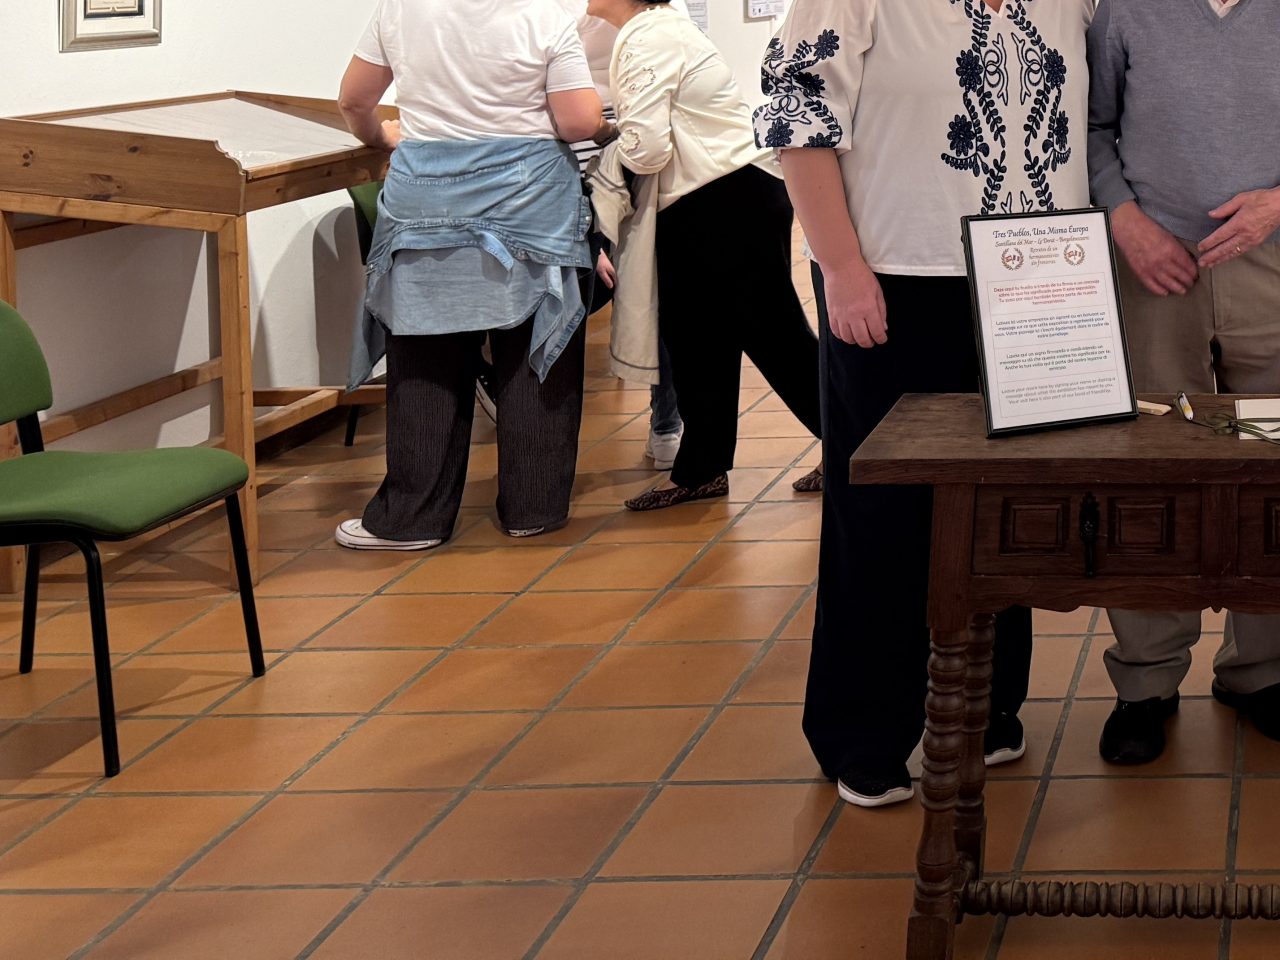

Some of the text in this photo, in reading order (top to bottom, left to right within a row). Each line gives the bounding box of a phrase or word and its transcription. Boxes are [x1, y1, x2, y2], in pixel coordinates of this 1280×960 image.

[1007, 227, 1031, 238] Pueblos,
[1046, 226, 1067, 234] Misma
[1068, 224, 1089, 236] Europa
